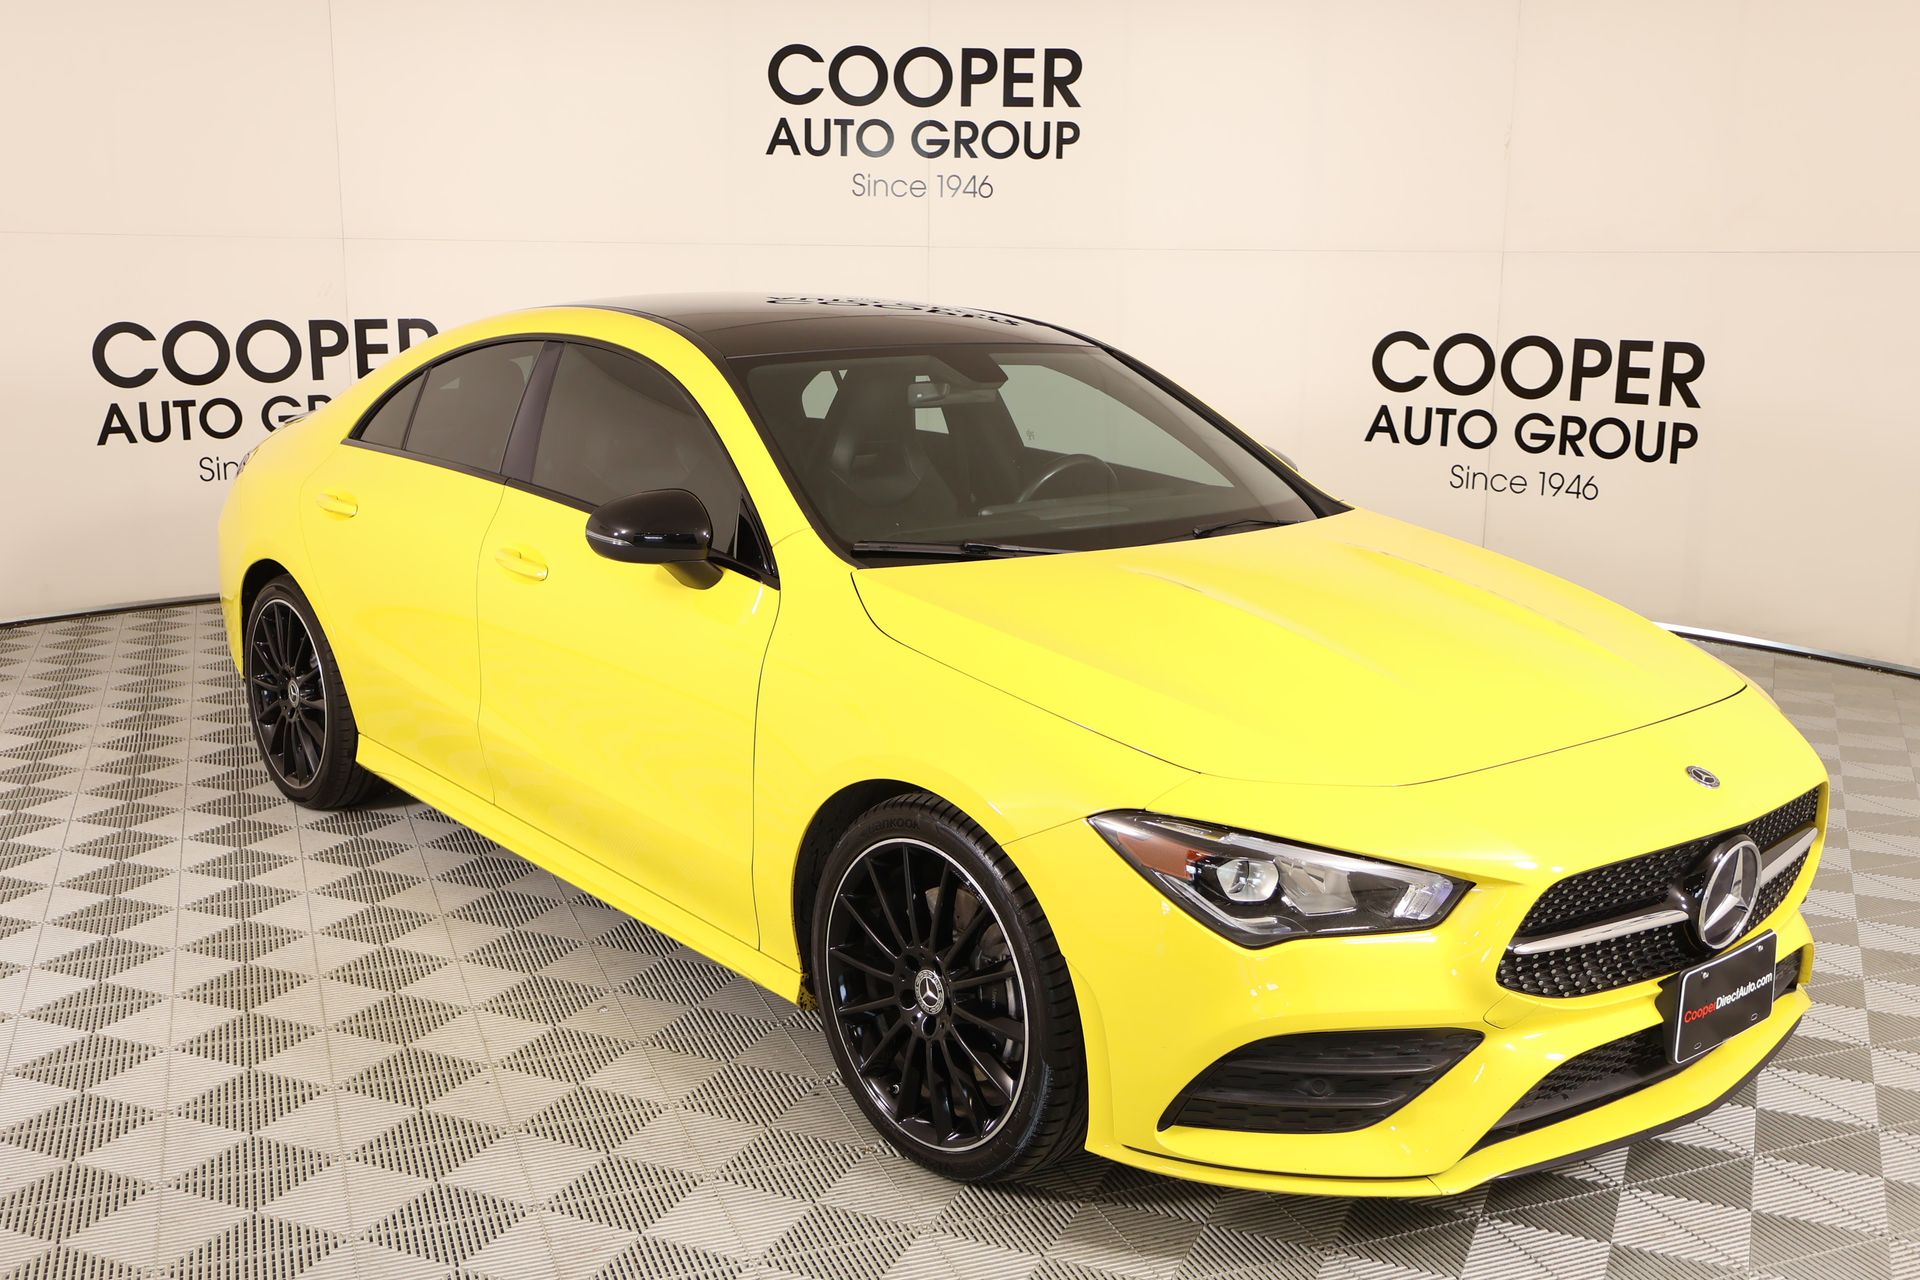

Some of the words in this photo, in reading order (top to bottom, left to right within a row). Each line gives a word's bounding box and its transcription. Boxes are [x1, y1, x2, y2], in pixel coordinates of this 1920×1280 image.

[767, 43, 1083, 109] COOPER
[765, 116, 895, 160] AUTO
[910, 119, 1081, 161] GROUP
[851, 173, 927, 198] Since
[937, 174, 994, 199] 1946
[1371, 330, 1706, 409] COOPER
[96, 397, 243, 447] AUTO
[1363, 404, 1498, 450] AUTO
[1514, 412, 1699, 465] GROUP
[1449, 464, 1528, 495] Since
[1538, 471, 1599, 501] 1946
[1684, 972, 1773, 1023] CooperDirectAuto.com
